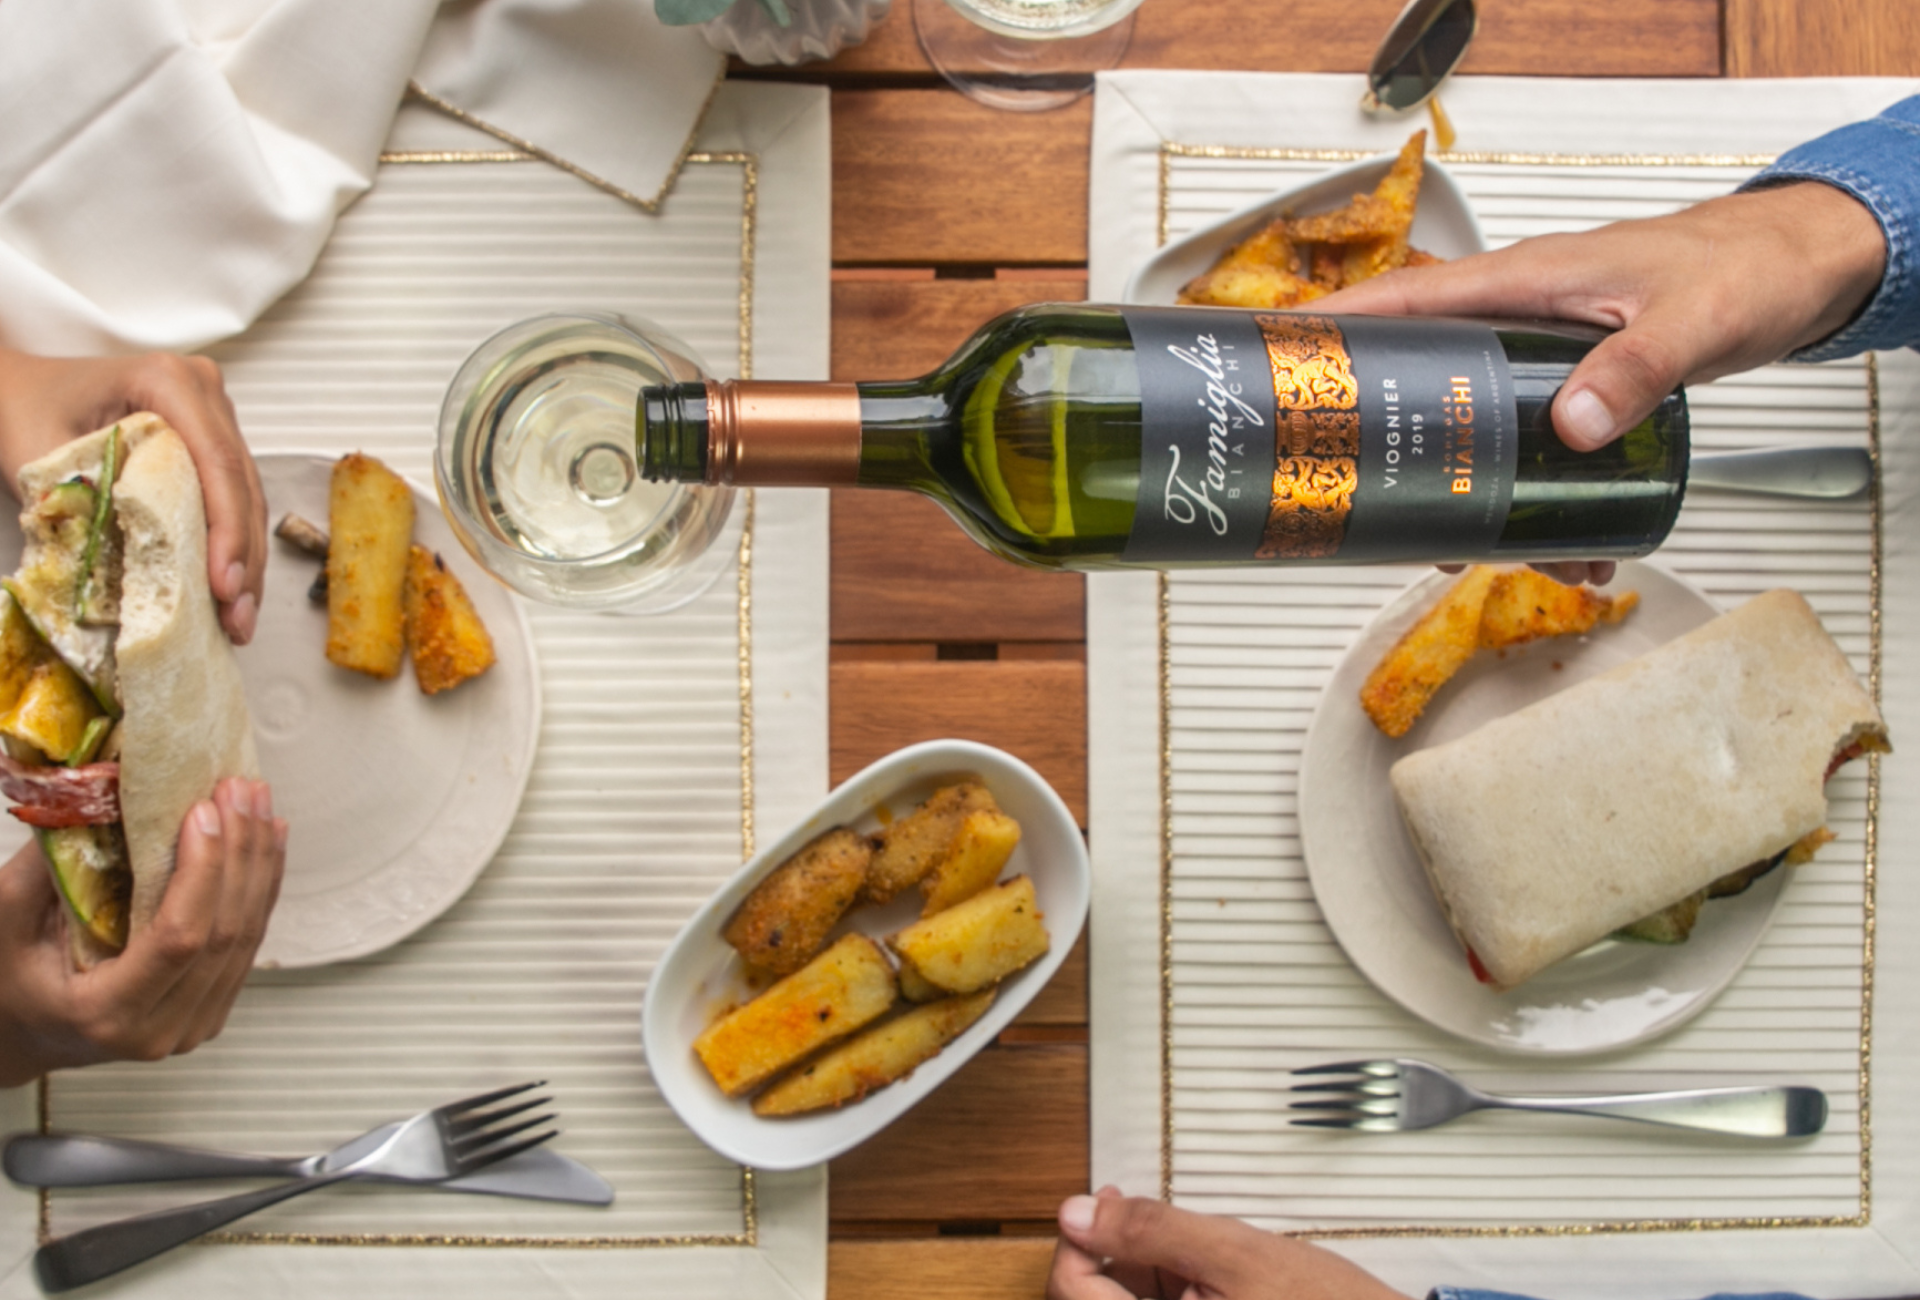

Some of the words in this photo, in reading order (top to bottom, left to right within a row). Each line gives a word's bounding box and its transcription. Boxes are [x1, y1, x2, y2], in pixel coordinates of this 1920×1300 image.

[1165, 333, 1264, 536] Famiglia
[1222, 344, 1245, 499] BIANCHI
[1383, 378, 1401, 489] VIOGNIER
[1411, 413, 1424, 455] 2019
[1450, 376, 1475, 494] BIANCHI
